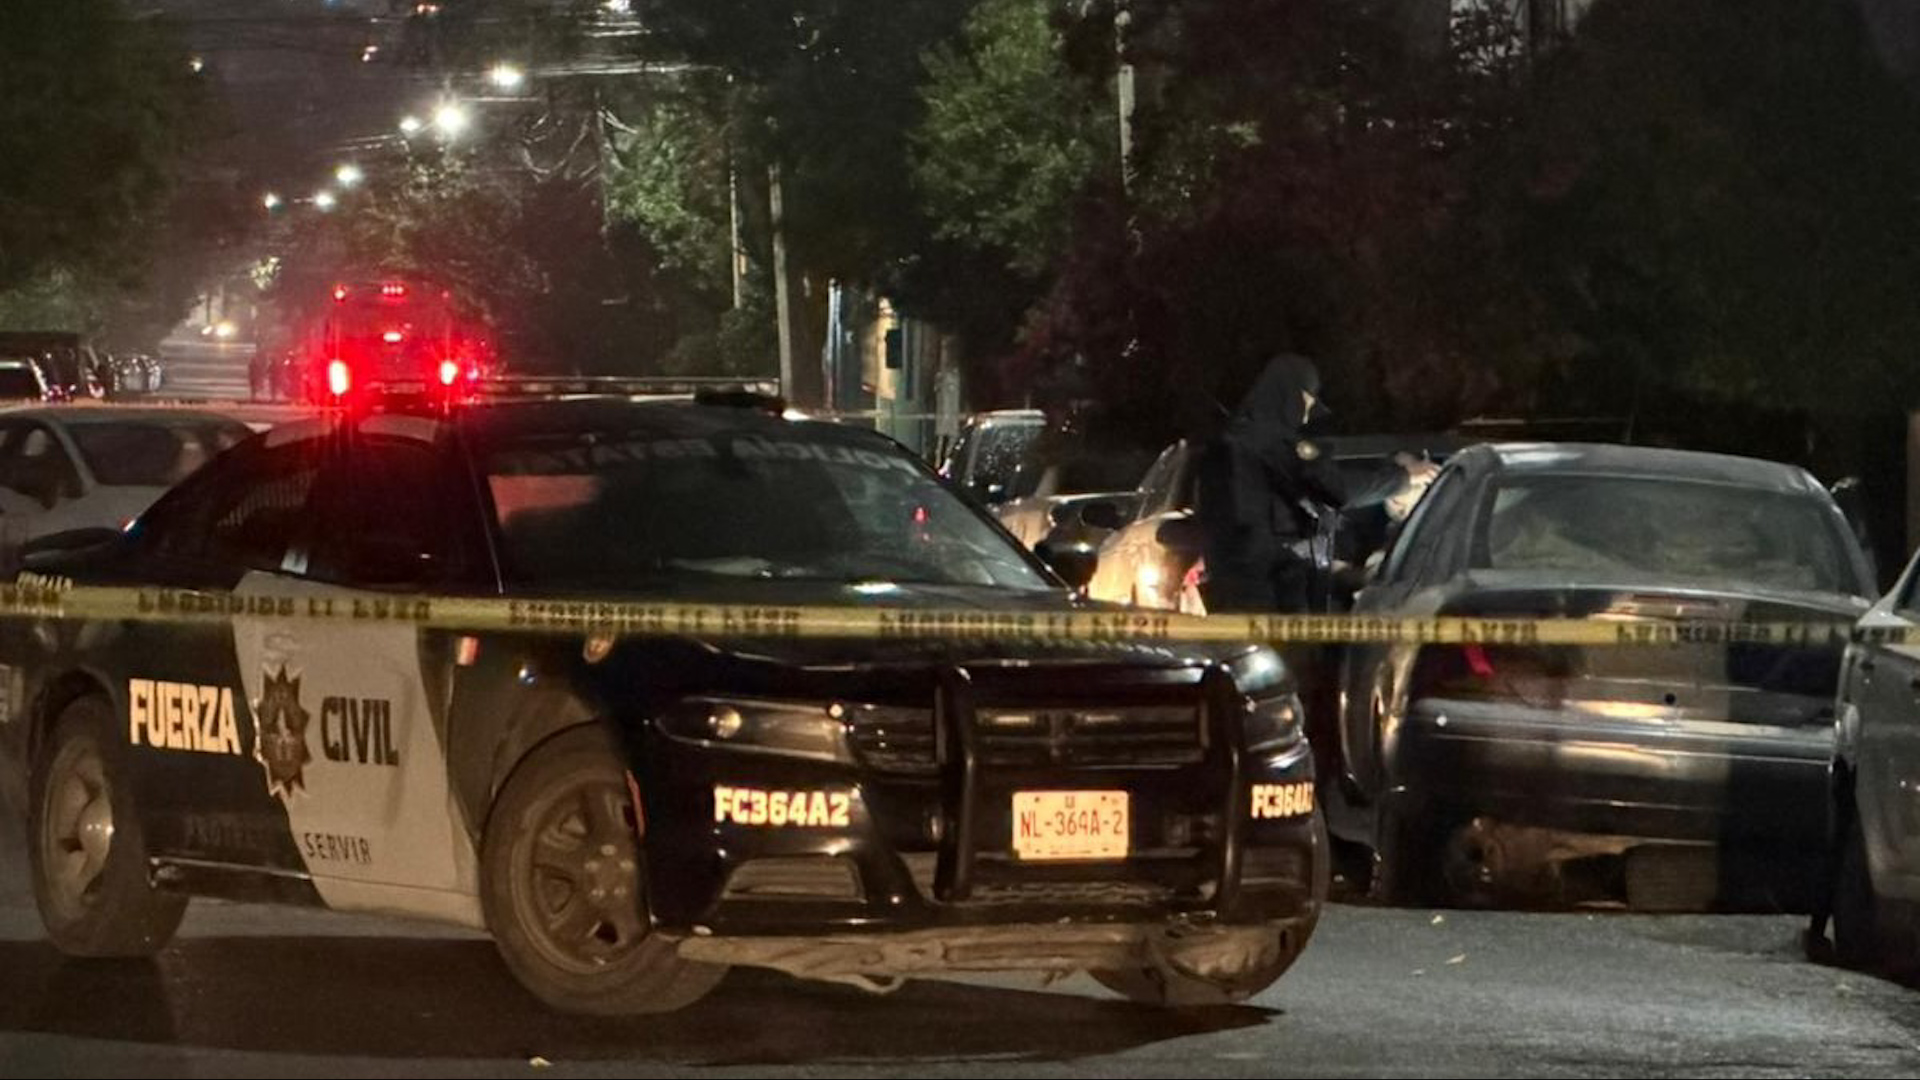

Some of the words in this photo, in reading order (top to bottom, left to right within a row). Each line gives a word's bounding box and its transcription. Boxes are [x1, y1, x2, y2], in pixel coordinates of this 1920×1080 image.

[129, 678, 241, 755] FUERZA
[320, 696, 399, 767] CIVIL
[714, 785, 851, 828] FC364A2
[1020, 808, 1124, 839] NL-364A-2
[303, 832, 372, 865] SERVIR
